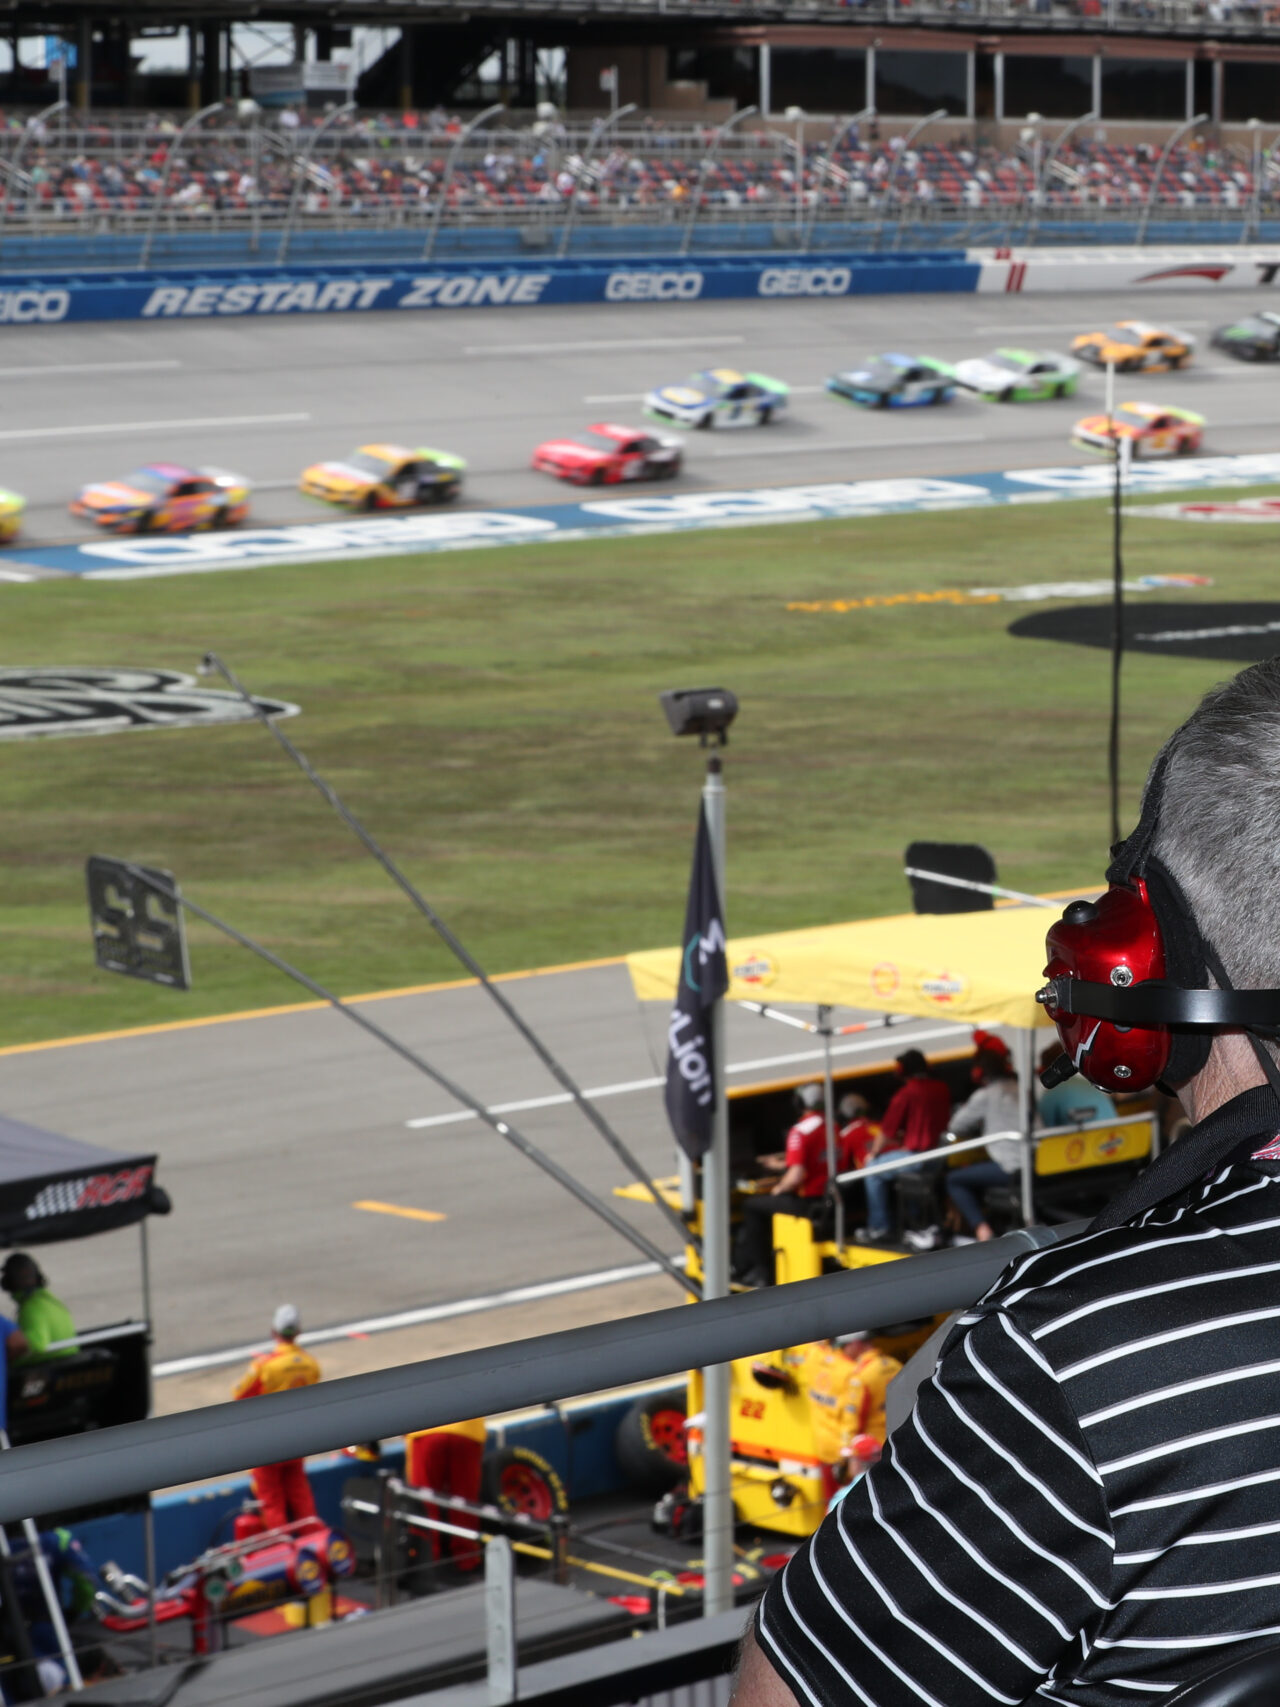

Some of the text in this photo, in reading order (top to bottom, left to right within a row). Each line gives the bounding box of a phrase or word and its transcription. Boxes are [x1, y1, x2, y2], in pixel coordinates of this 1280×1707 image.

[141, 273, 552, 317] RESTART ZONE
[604, 271, 704, 301] GEICO
[757, 267, 853, 296] GEICO
[0, 289, 71, 322] ICO
